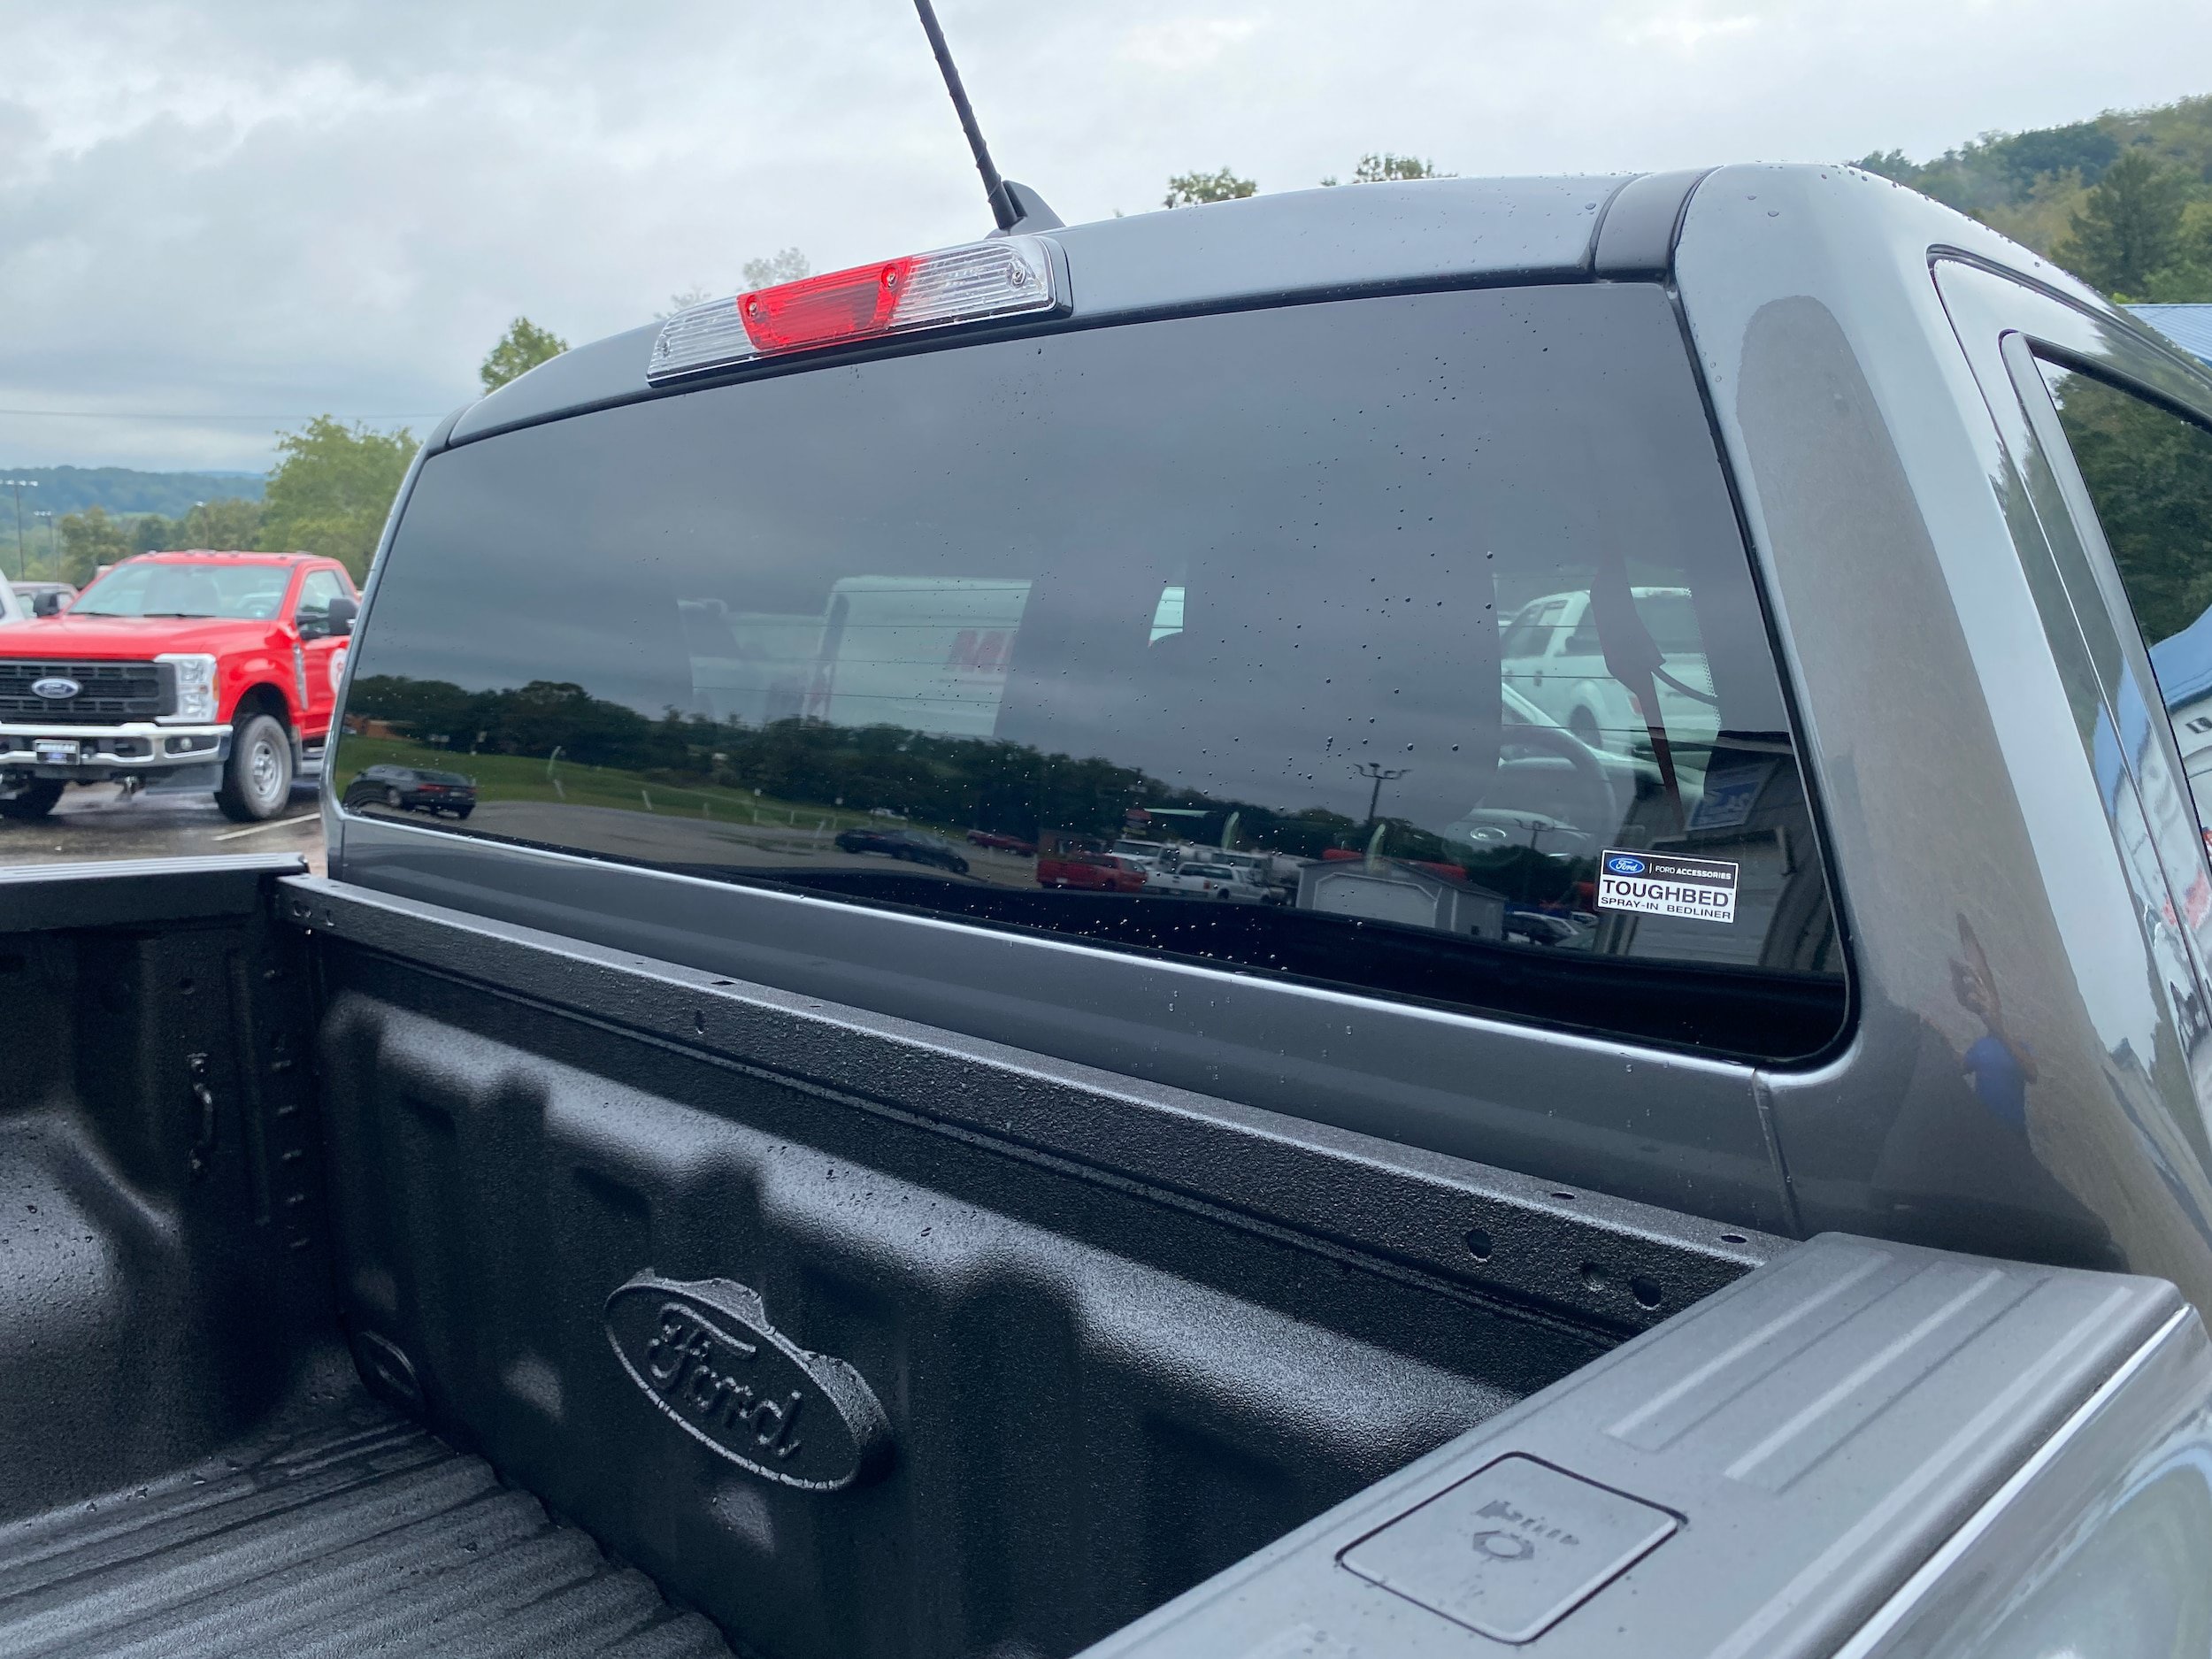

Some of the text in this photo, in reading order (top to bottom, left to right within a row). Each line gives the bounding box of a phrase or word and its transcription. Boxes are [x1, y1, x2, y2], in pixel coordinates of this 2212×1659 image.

[1615, 859, 1640, 872] Ford
[1655, 864, 1732, 880] FORD ACCESSORIES
[1601, 896, 1731, 919] SPRAY-IN BEDLINER
[647, 1302, 803, 1457] Ford
